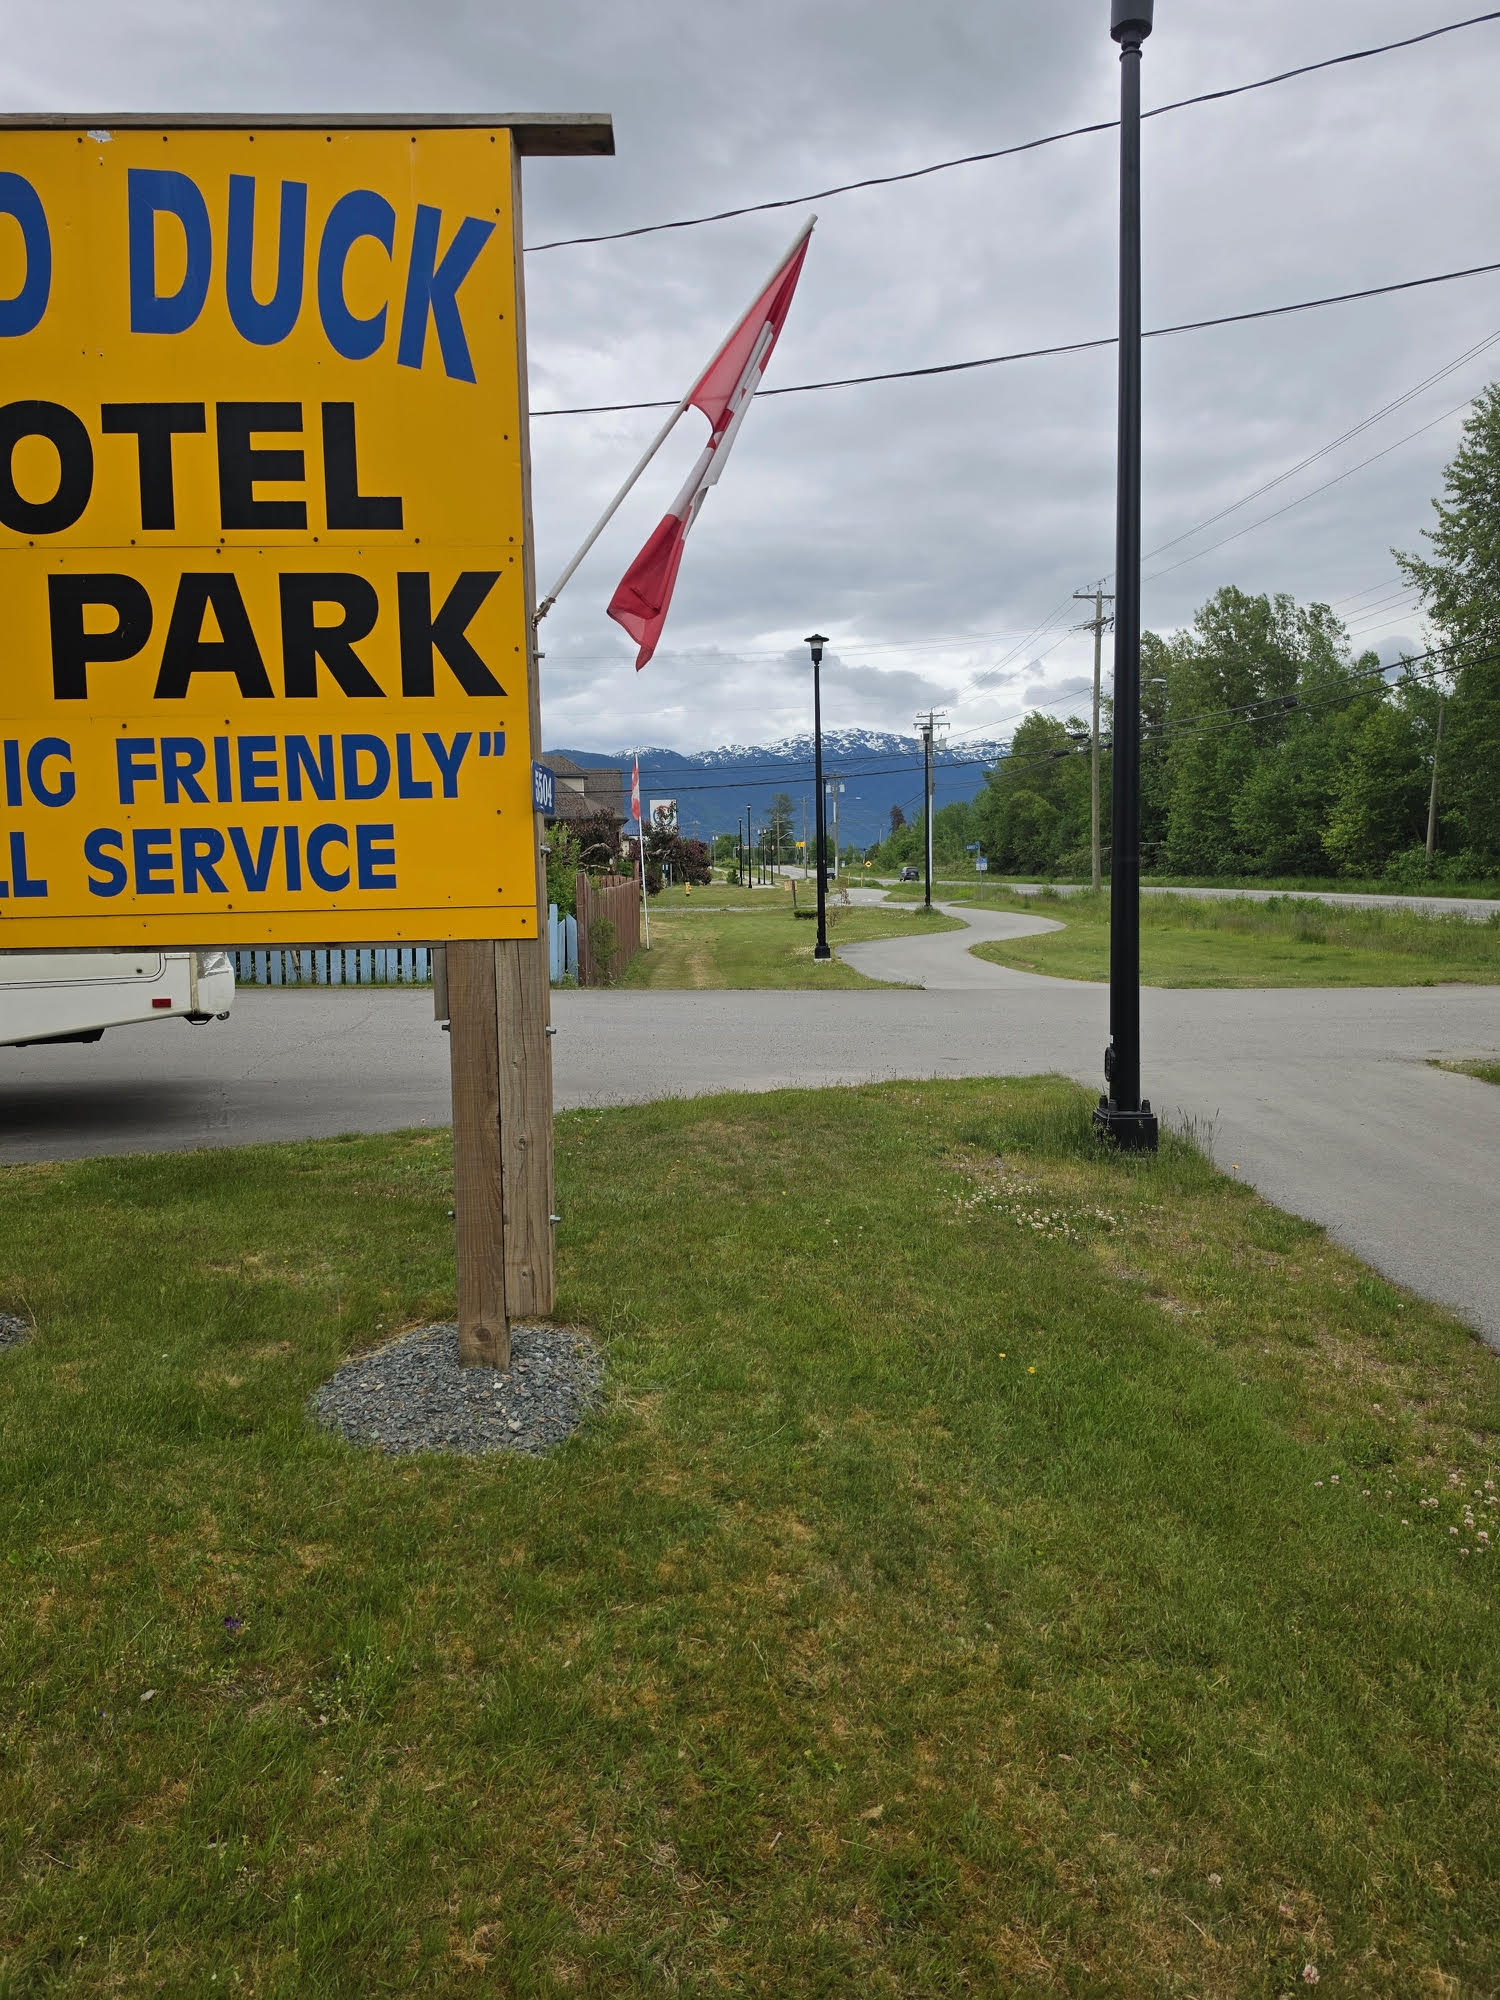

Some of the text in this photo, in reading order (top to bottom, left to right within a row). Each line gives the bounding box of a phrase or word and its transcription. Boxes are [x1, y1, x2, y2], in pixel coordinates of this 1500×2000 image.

[128, 168, 496, 384] DUCK
[0, 400, 403, 534] OTEL
[48, 571, 508, 699] PARK
[4, 737, 75, 807] IG
[0, 824, 396, 898] L SERVICE
